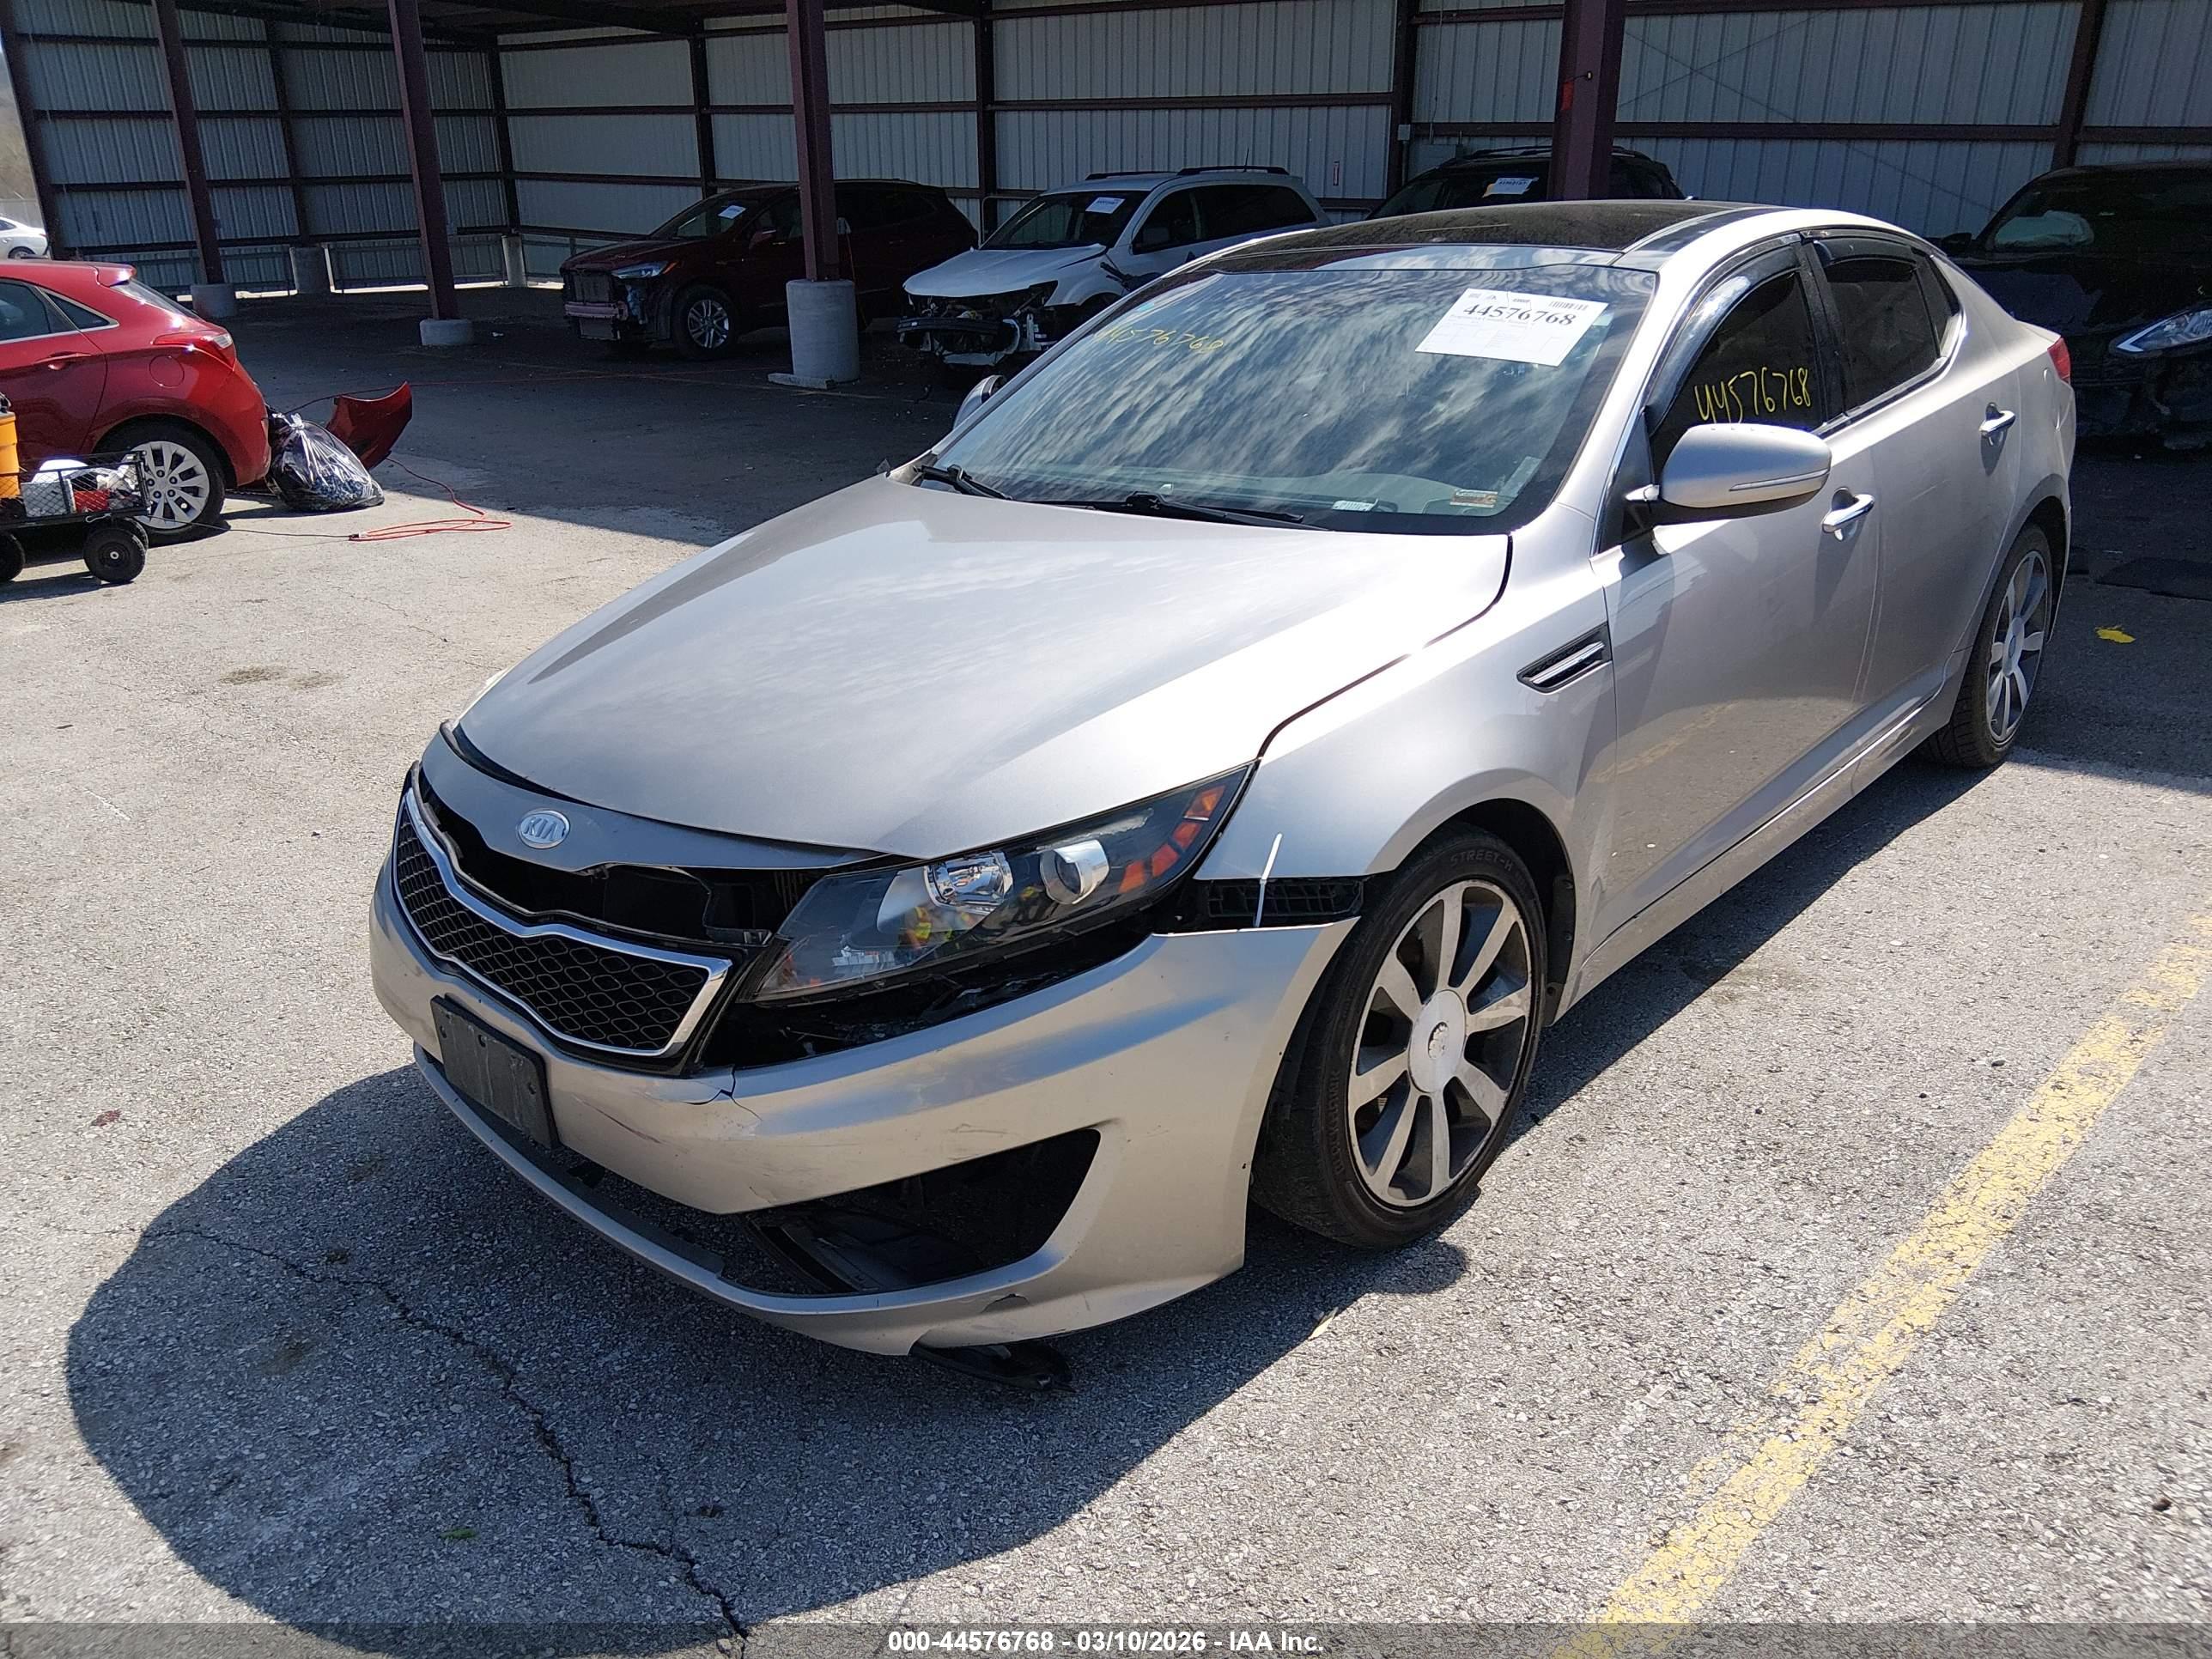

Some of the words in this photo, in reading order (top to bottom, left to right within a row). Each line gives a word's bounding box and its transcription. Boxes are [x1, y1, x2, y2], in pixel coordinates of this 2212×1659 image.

[1463, 303, 1577, 326] 44576768
[1694, 367, 1811, 424] 44576768
[523, 816, 558, 842] KIA
[1449, 848, 1514, 872] STREET-H
